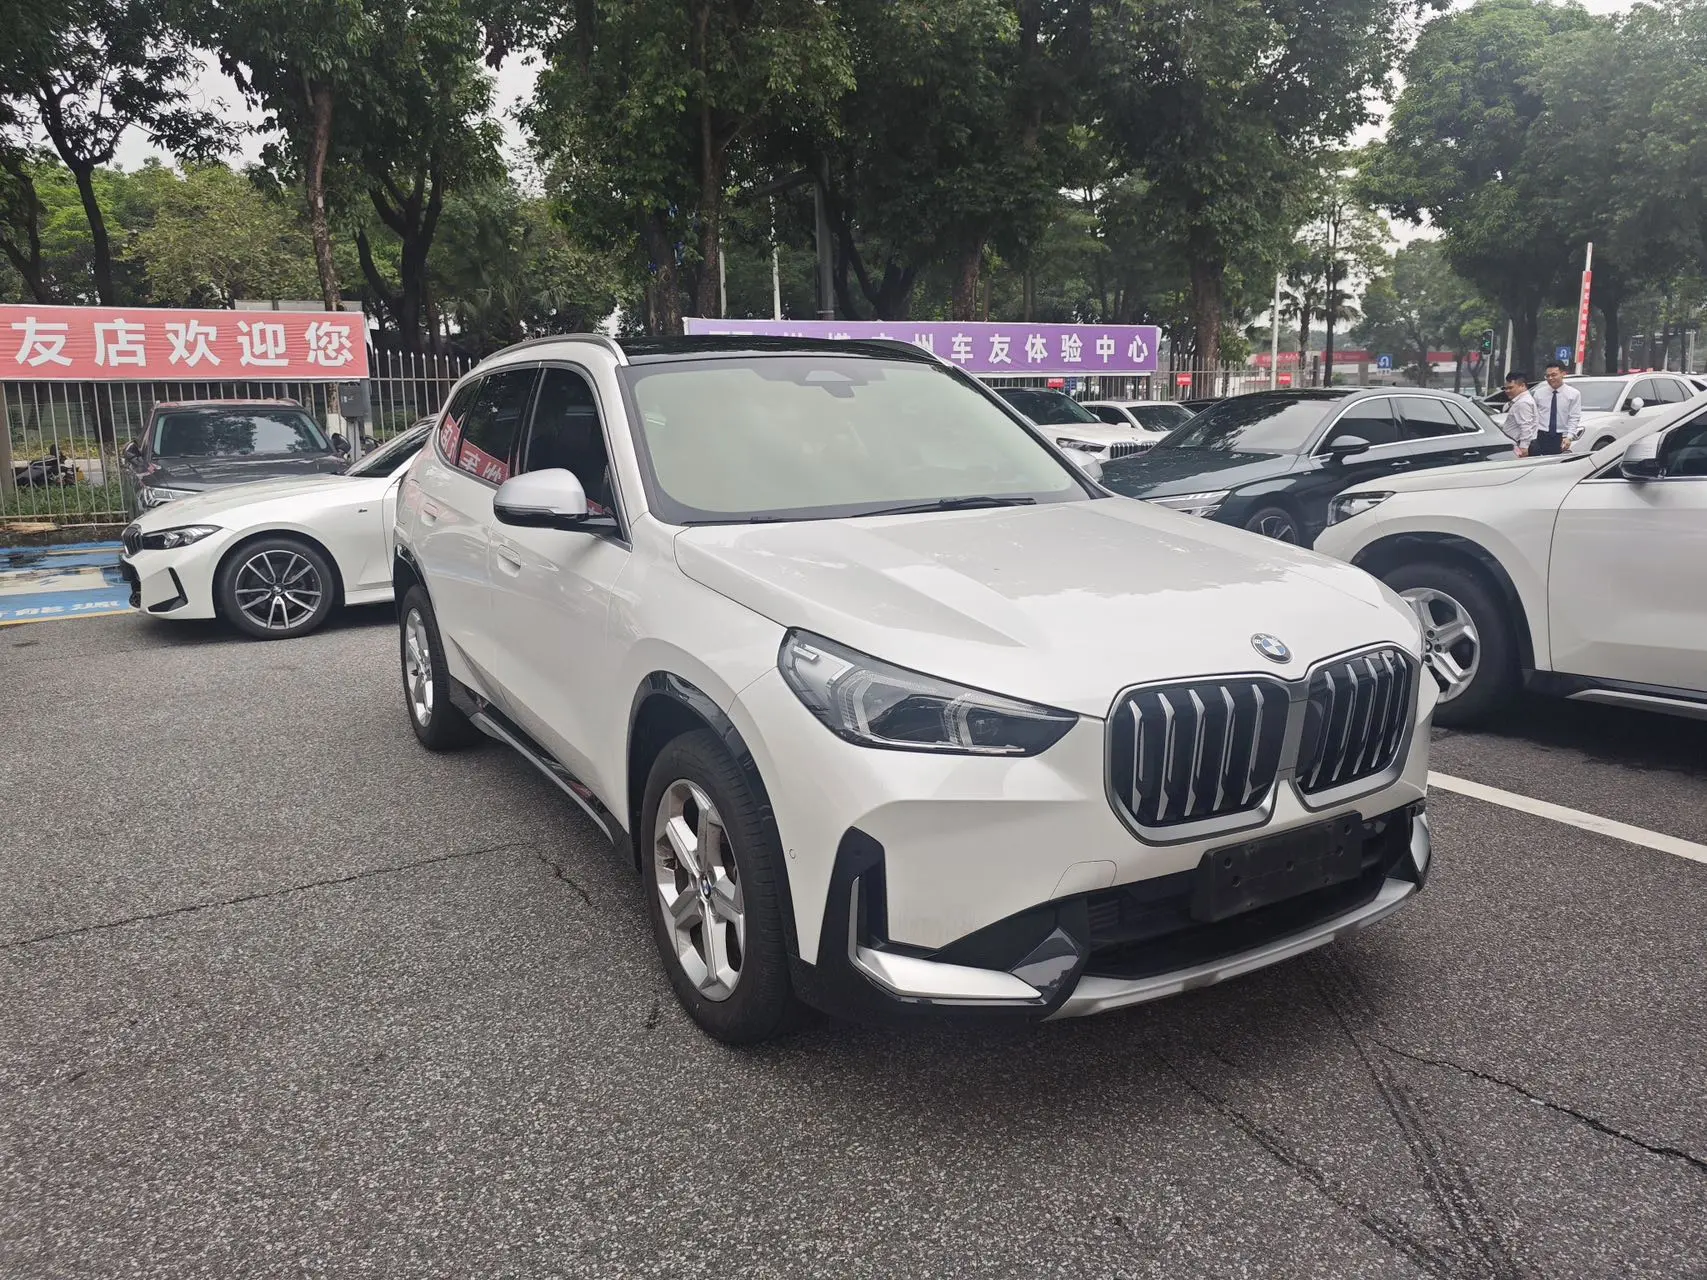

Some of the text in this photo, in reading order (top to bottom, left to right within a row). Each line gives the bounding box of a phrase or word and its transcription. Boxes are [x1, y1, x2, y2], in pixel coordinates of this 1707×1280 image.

[11, 317, 355, 367] 友店欢迎您
